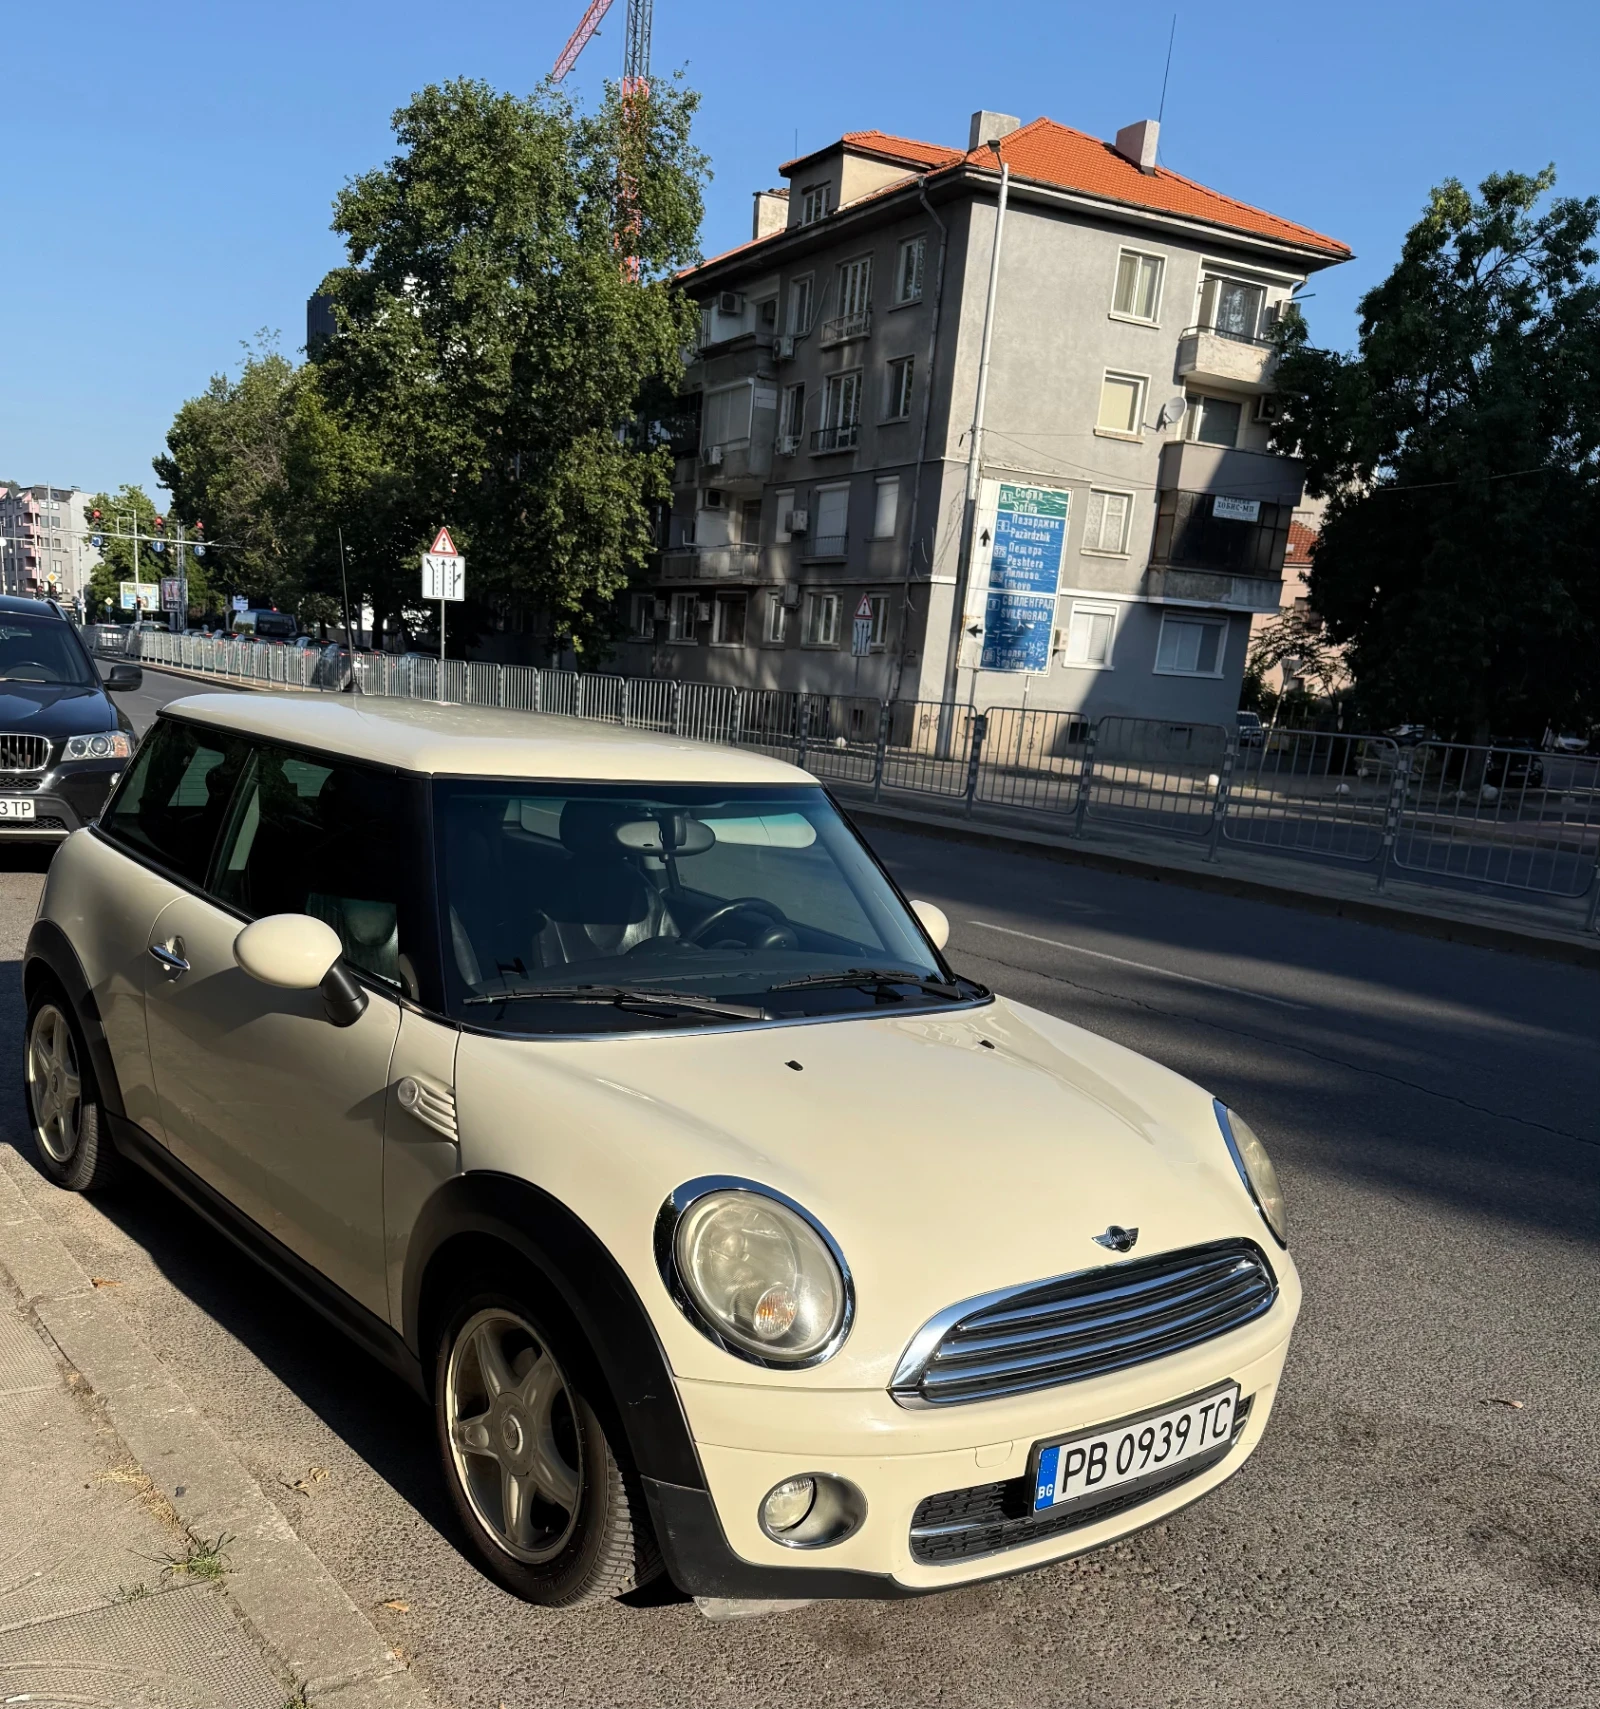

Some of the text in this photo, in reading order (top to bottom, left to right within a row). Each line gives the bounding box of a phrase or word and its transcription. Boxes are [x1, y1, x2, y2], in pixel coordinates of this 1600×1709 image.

[1015, 487, 1043, 501] София
[1012, 513, 1060, 530] Пазарджик
[1010, 527, 1051, 543] Pazardzhik
[1006, 554, 1044, 569] Peshtera
[1005, 567, 1039, 580] Лилково
[1002, 595, 1054, 611] СВИЛЕНГРАД
[1000, 607, 1048, 622] SVILENGRAD
[11, 801, 31, 816] TP
[1062, 1397, 1231, 1494] PB 0939 TC
[1037, 1483, 1053, 1500] BG
